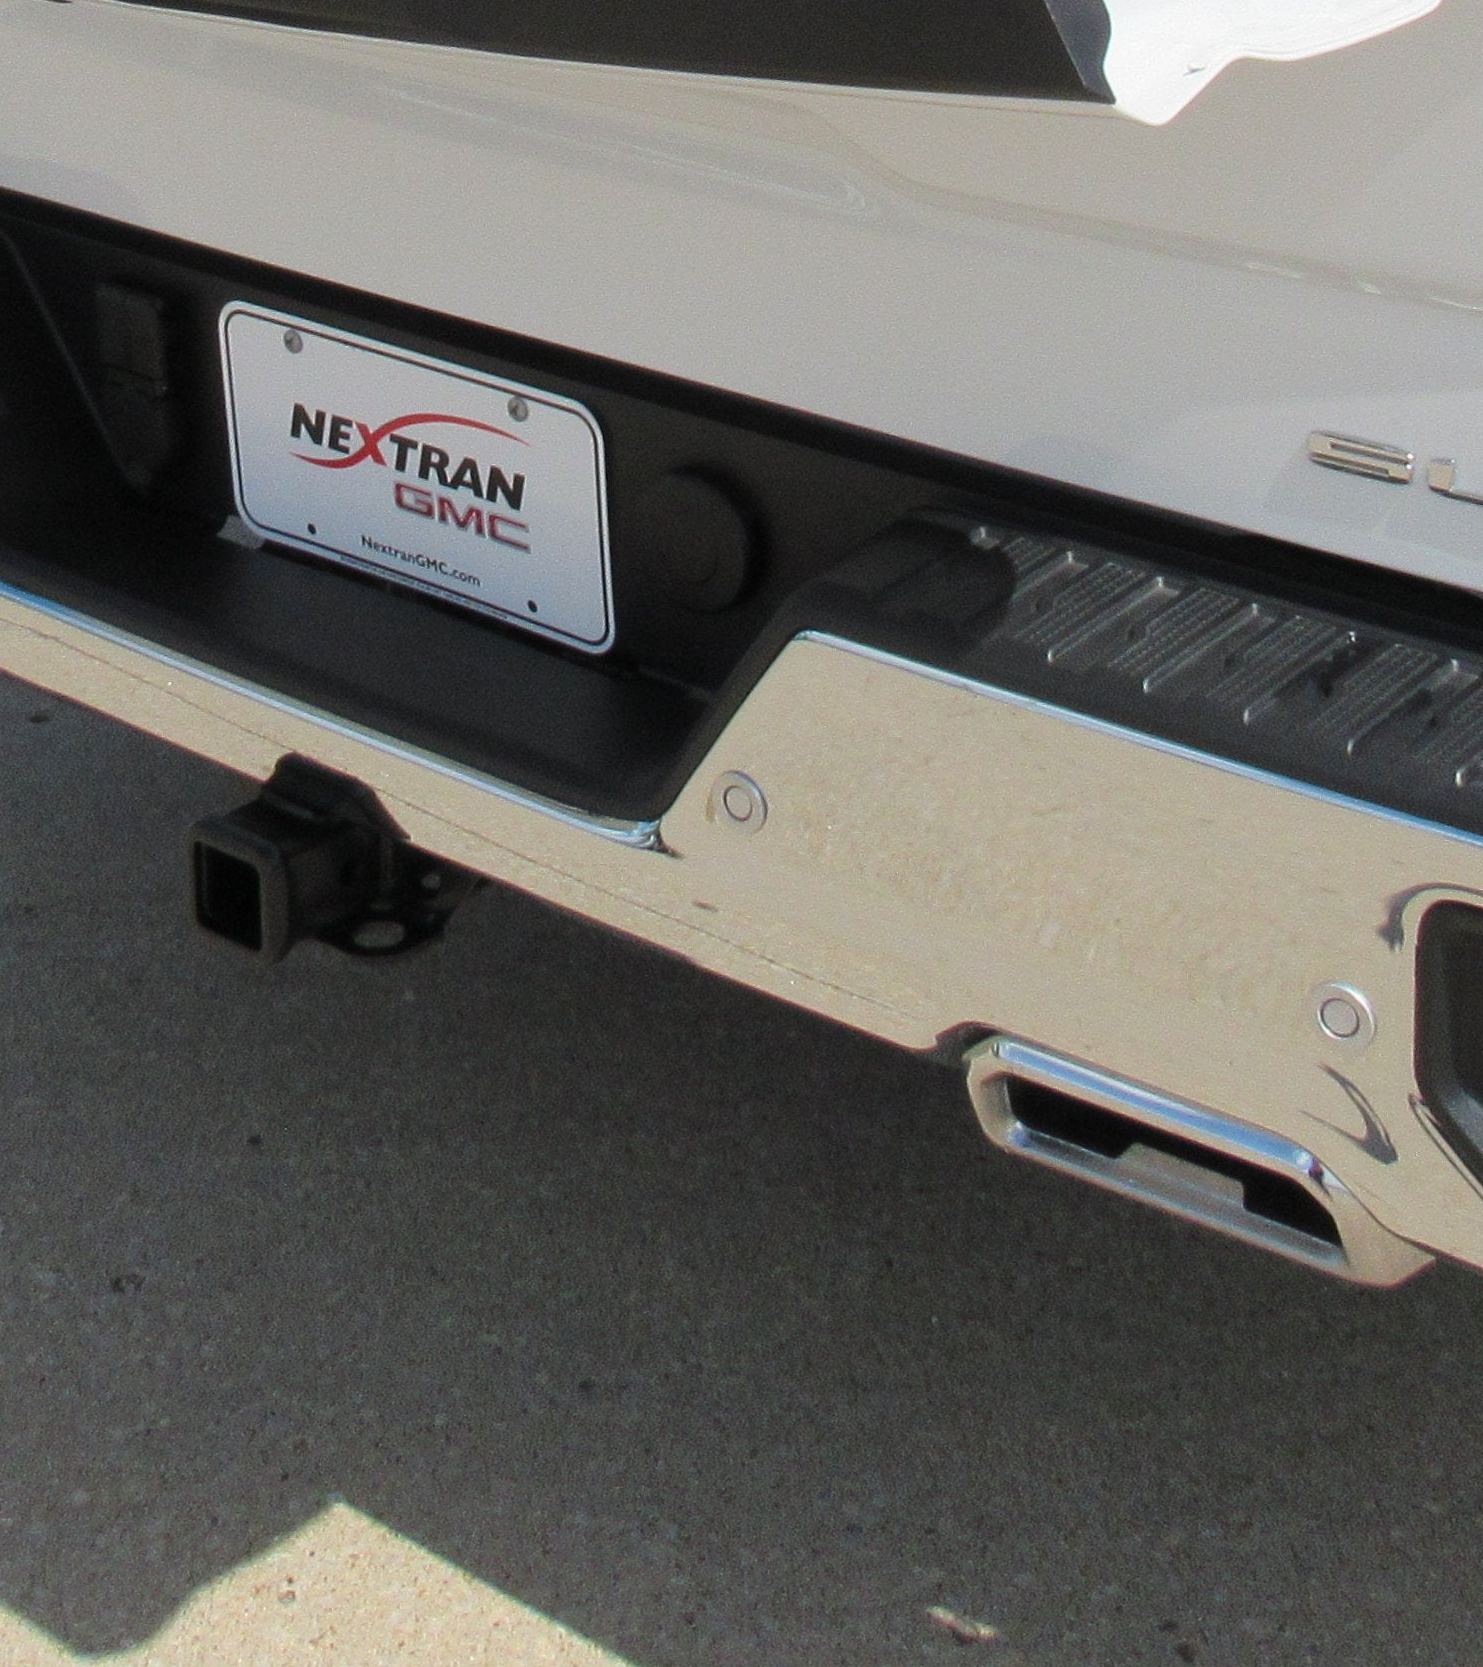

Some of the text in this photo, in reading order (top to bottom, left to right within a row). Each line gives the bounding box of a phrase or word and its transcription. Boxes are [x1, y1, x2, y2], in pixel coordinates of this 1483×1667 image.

[289, 402, 526, 511] NEXTRAN
[394, 482, 531, 553] GMC
[360, 534, 482, 588] NextranGMC.com
